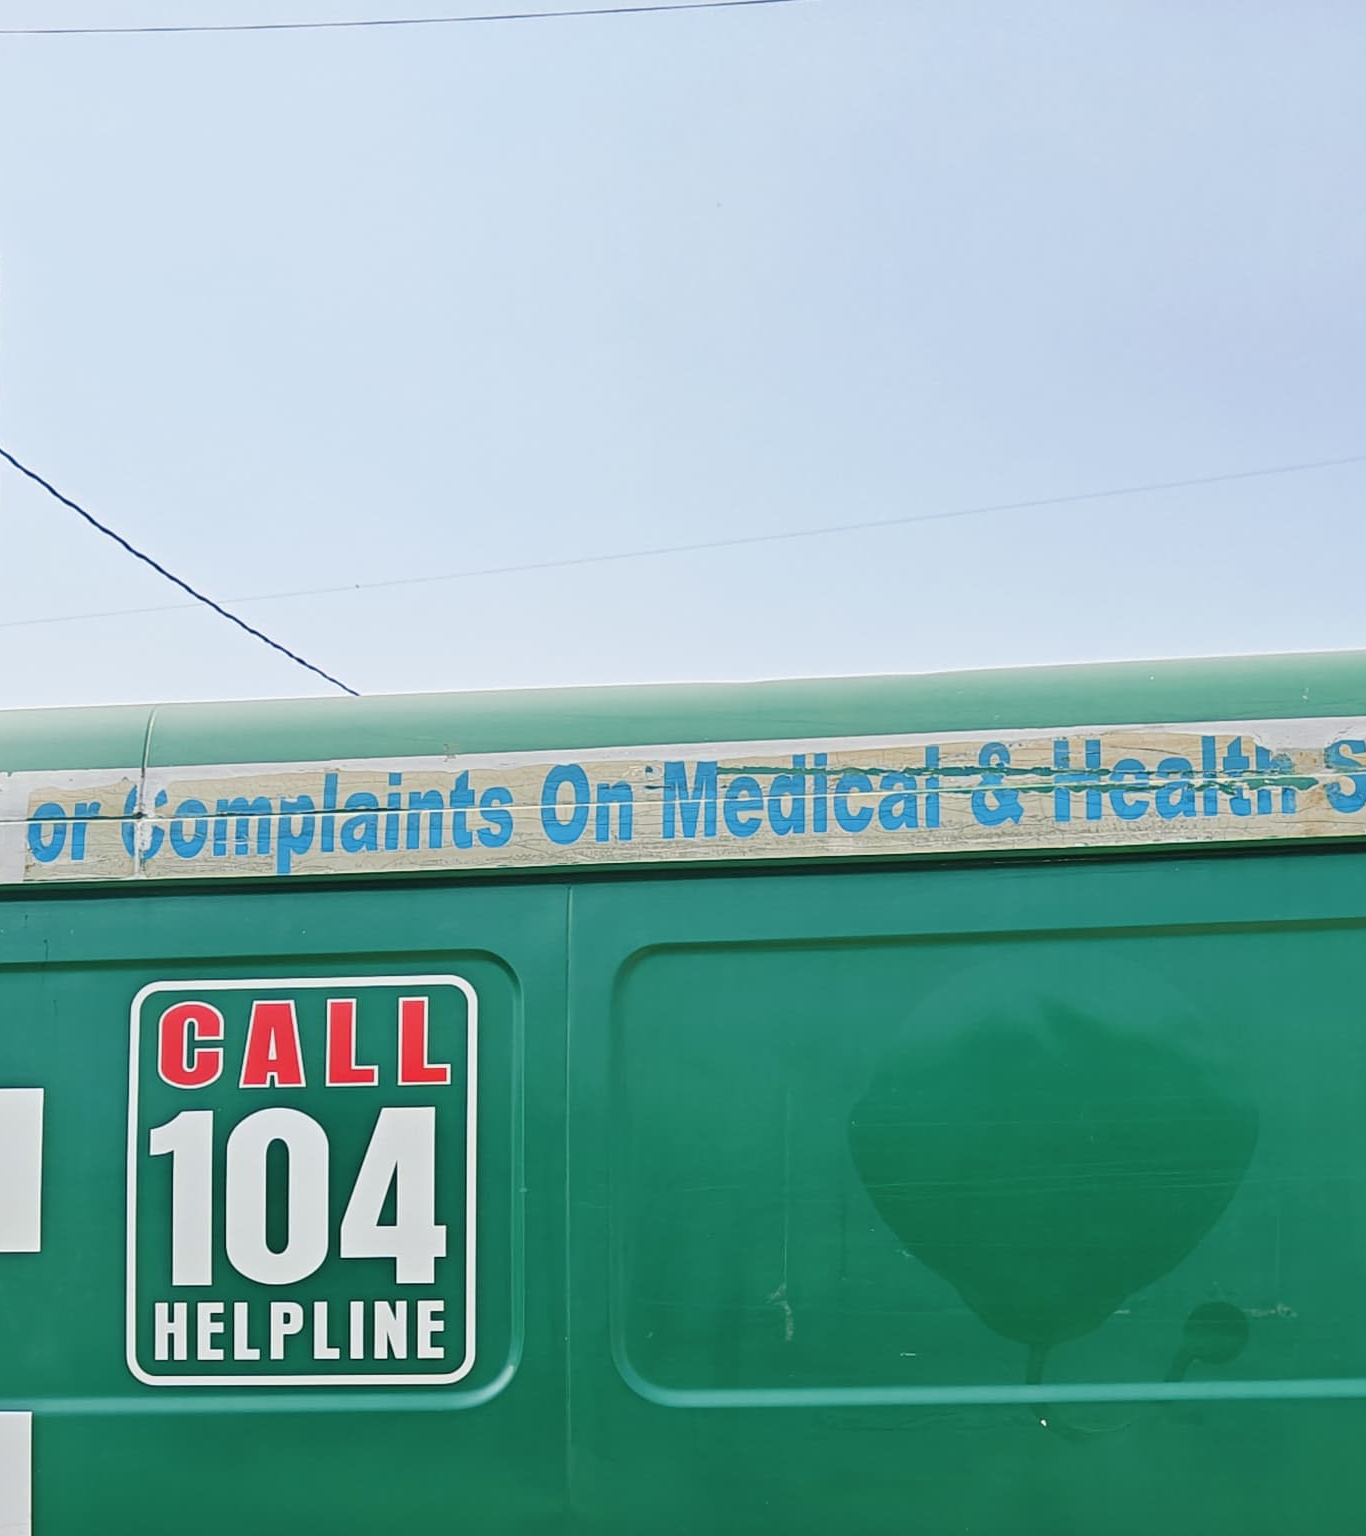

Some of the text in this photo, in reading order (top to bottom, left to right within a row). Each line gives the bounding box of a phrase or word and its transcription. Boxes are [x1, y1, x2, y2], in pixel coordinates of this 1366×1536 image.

[122, 771, 513, 876] Complaints
[542, 764, 633, 845] On
[663, 746, 939, 839] Medical
[972, 742, 1025, 828] &
[1054, 735, 1296, 823] Health
[158, 996, 451, 1089] CALL
[149, 1106, 447, 1286] 104
[154, 1299, 446, 1361] HELPLINE
